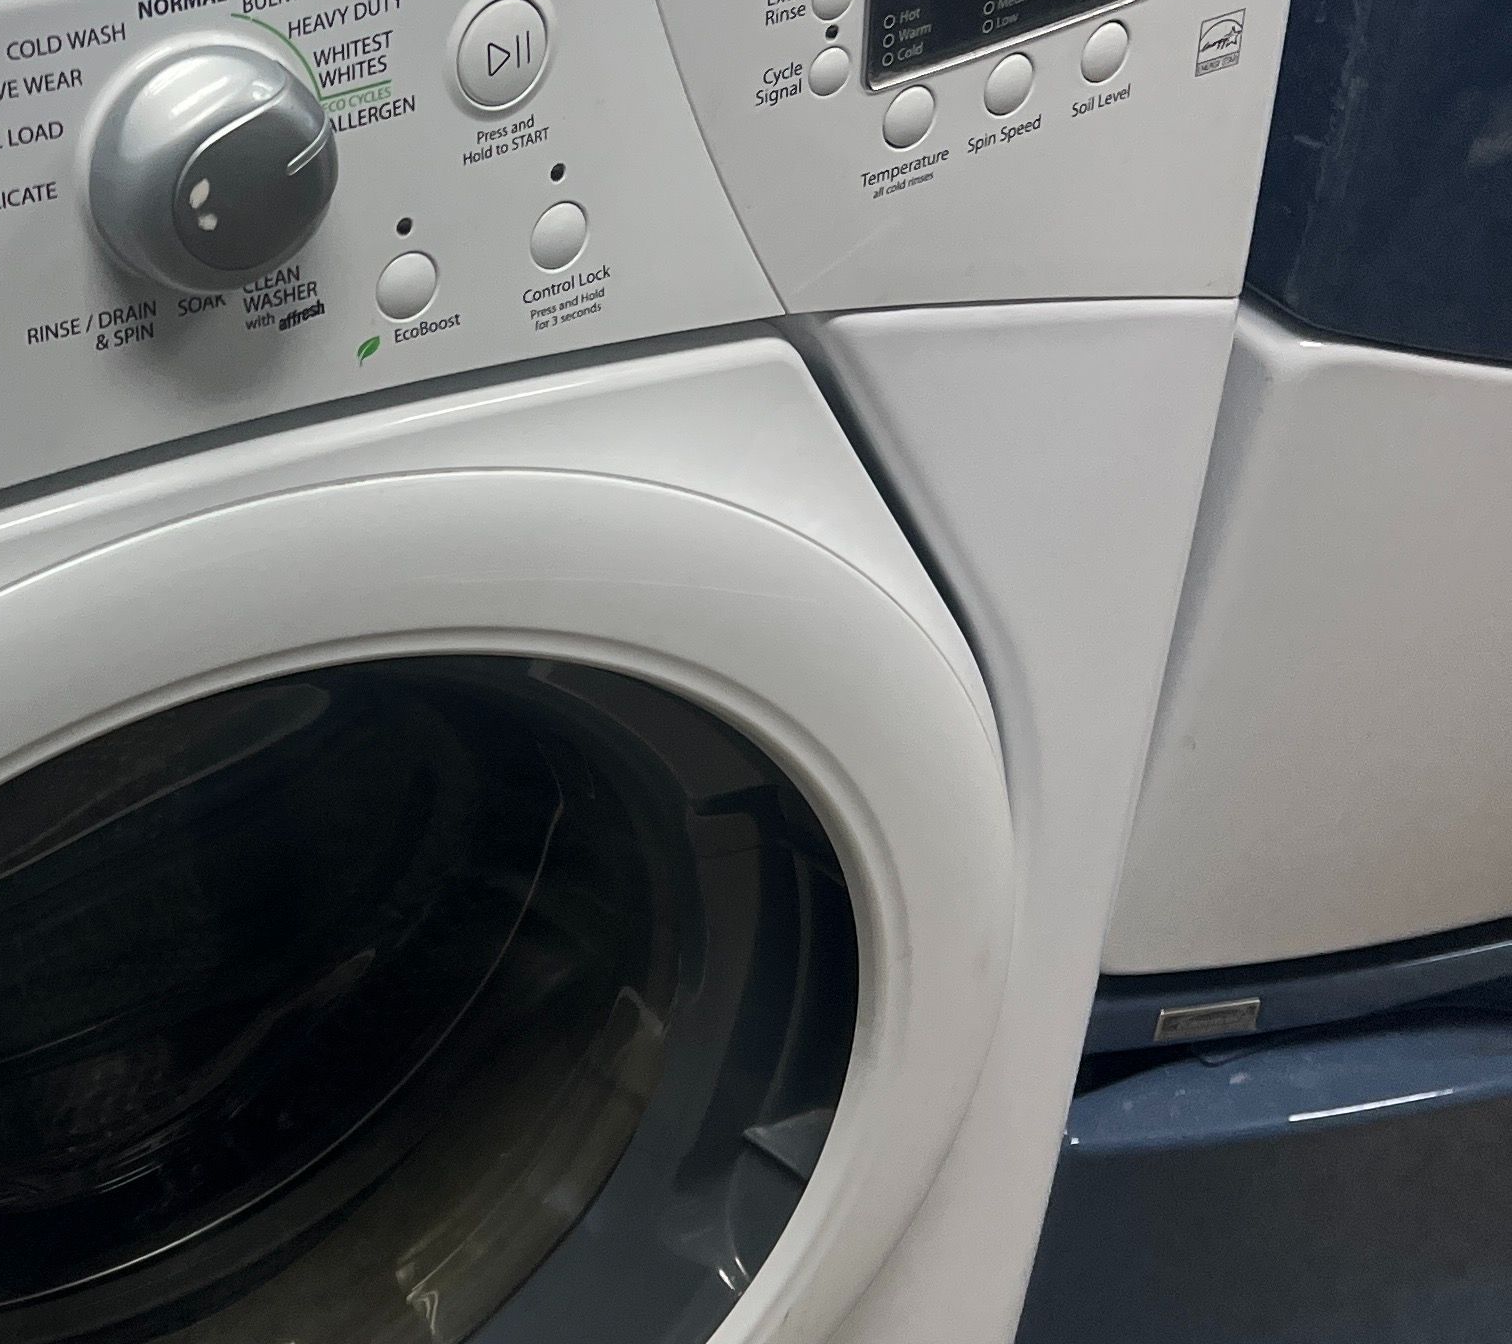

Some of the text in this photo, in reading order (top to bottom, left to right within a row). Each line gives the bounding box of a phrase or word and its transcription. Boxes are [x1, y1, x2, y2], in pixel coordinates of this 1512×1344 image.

[288, 7, 350, 39] HEAVY
[765, 2, 806, 27] Rinse
[899, 8, 921, 24] Hot
[996, 13, 1019, 29] Low
[7, 23, 127, 60] COLD WASH
[313, 30, 394, 67] WHITEST
[898, 23, 932, 42] Warm
[897, 42, 924, 62] Cold
[23, 68, 84, 96] WEAR
[318, 55, 388, 89] WHITES
[762, 61, 803, 87] Cycle
[348, 86, 392, 107] CYCLES
[755, 80, 803, 107] Signal
[1071, 84, 1131, 118] Soil Level
[8, 120, 65, 148] LOAD
[477, 113, 535, 145] Press and
[967, 114, 1042, 154] Spin Speed
[463, 127, 550, 165] Hold to START
[861, 149, 949, 187] Temperature
[873, 172, 934, 199] all cold rinses
[243, 281, 317, 314] WASHER
[522, 264, 611, 304] Control Lock
[178, 294, 226, 317] SOAK
[245, 299, 326, 332] with affresh
[530, 287, 605, 320] Press and Hold
[535, 302, 602, 331] for 3 seconds
[27, 300, 157, 345] RINSE / DRAIN
[95, 322, 156, 351] & SPIN
[393, 312, 461, 344] EcoBoost
